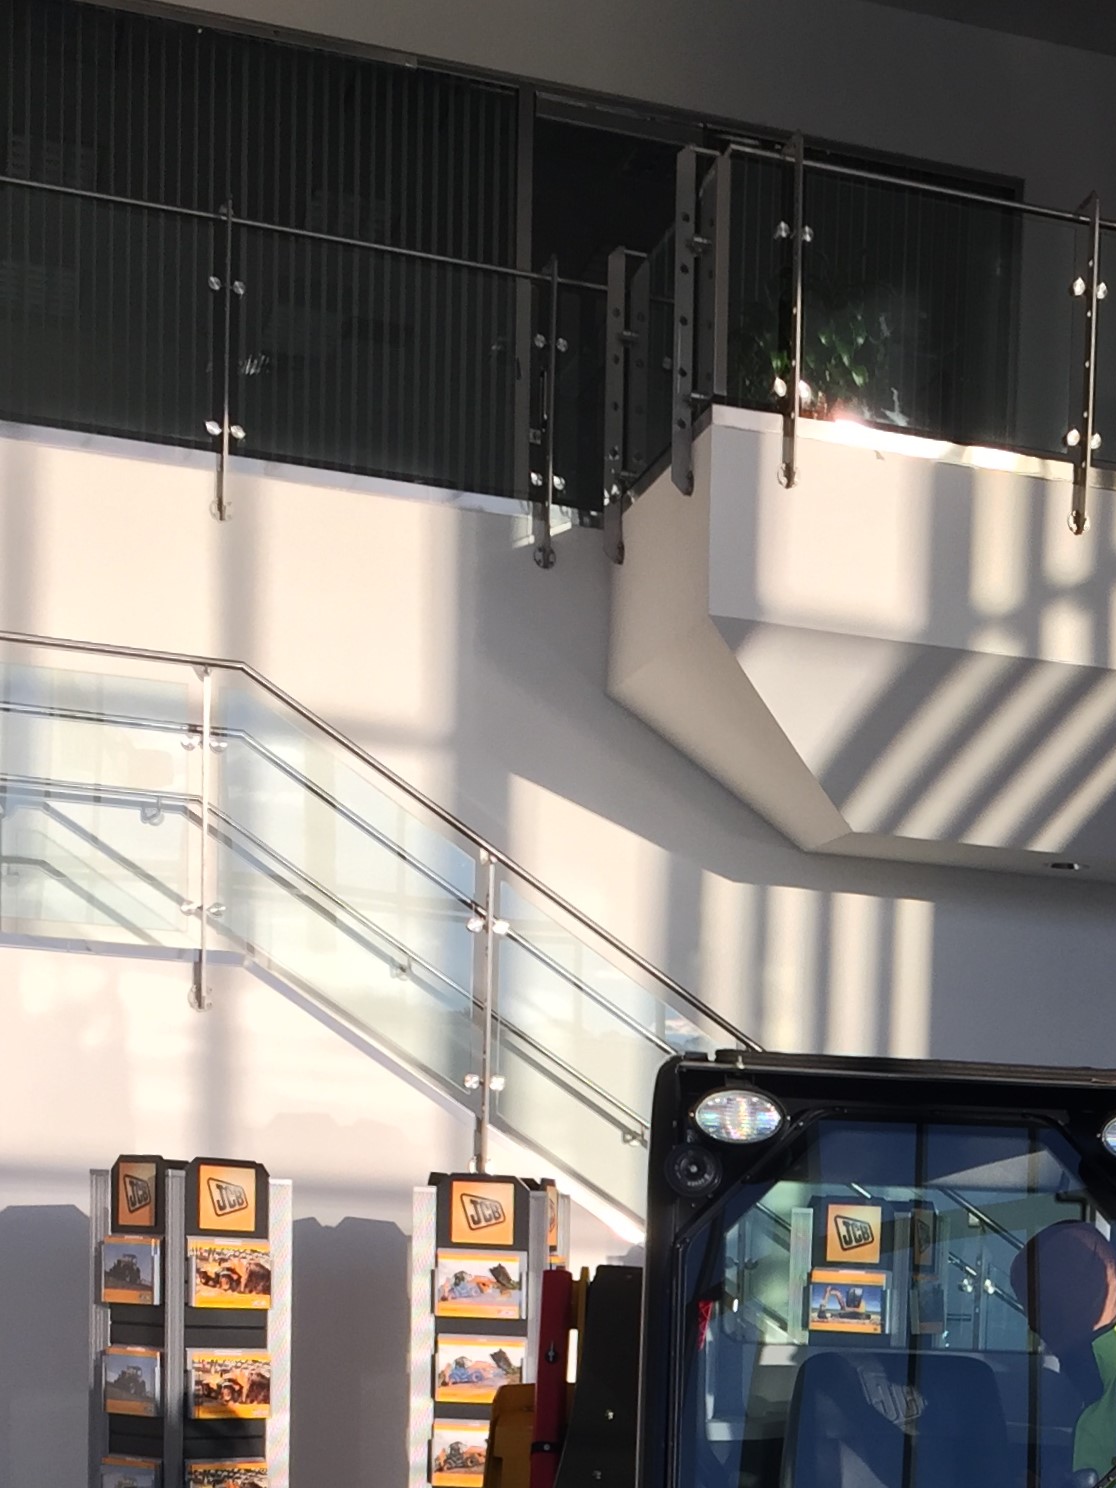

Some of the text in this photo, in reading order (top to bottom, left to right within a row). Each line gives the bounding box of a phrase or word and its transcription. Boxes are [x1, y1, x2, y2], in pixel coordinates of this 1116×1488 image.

[129, 1180, 149, 1207] JCB
[215, 1183, 245, 1212] JCB
[469, 1199, 502, 1226] JCB
[841, 1220, 872, 1247] JCB
